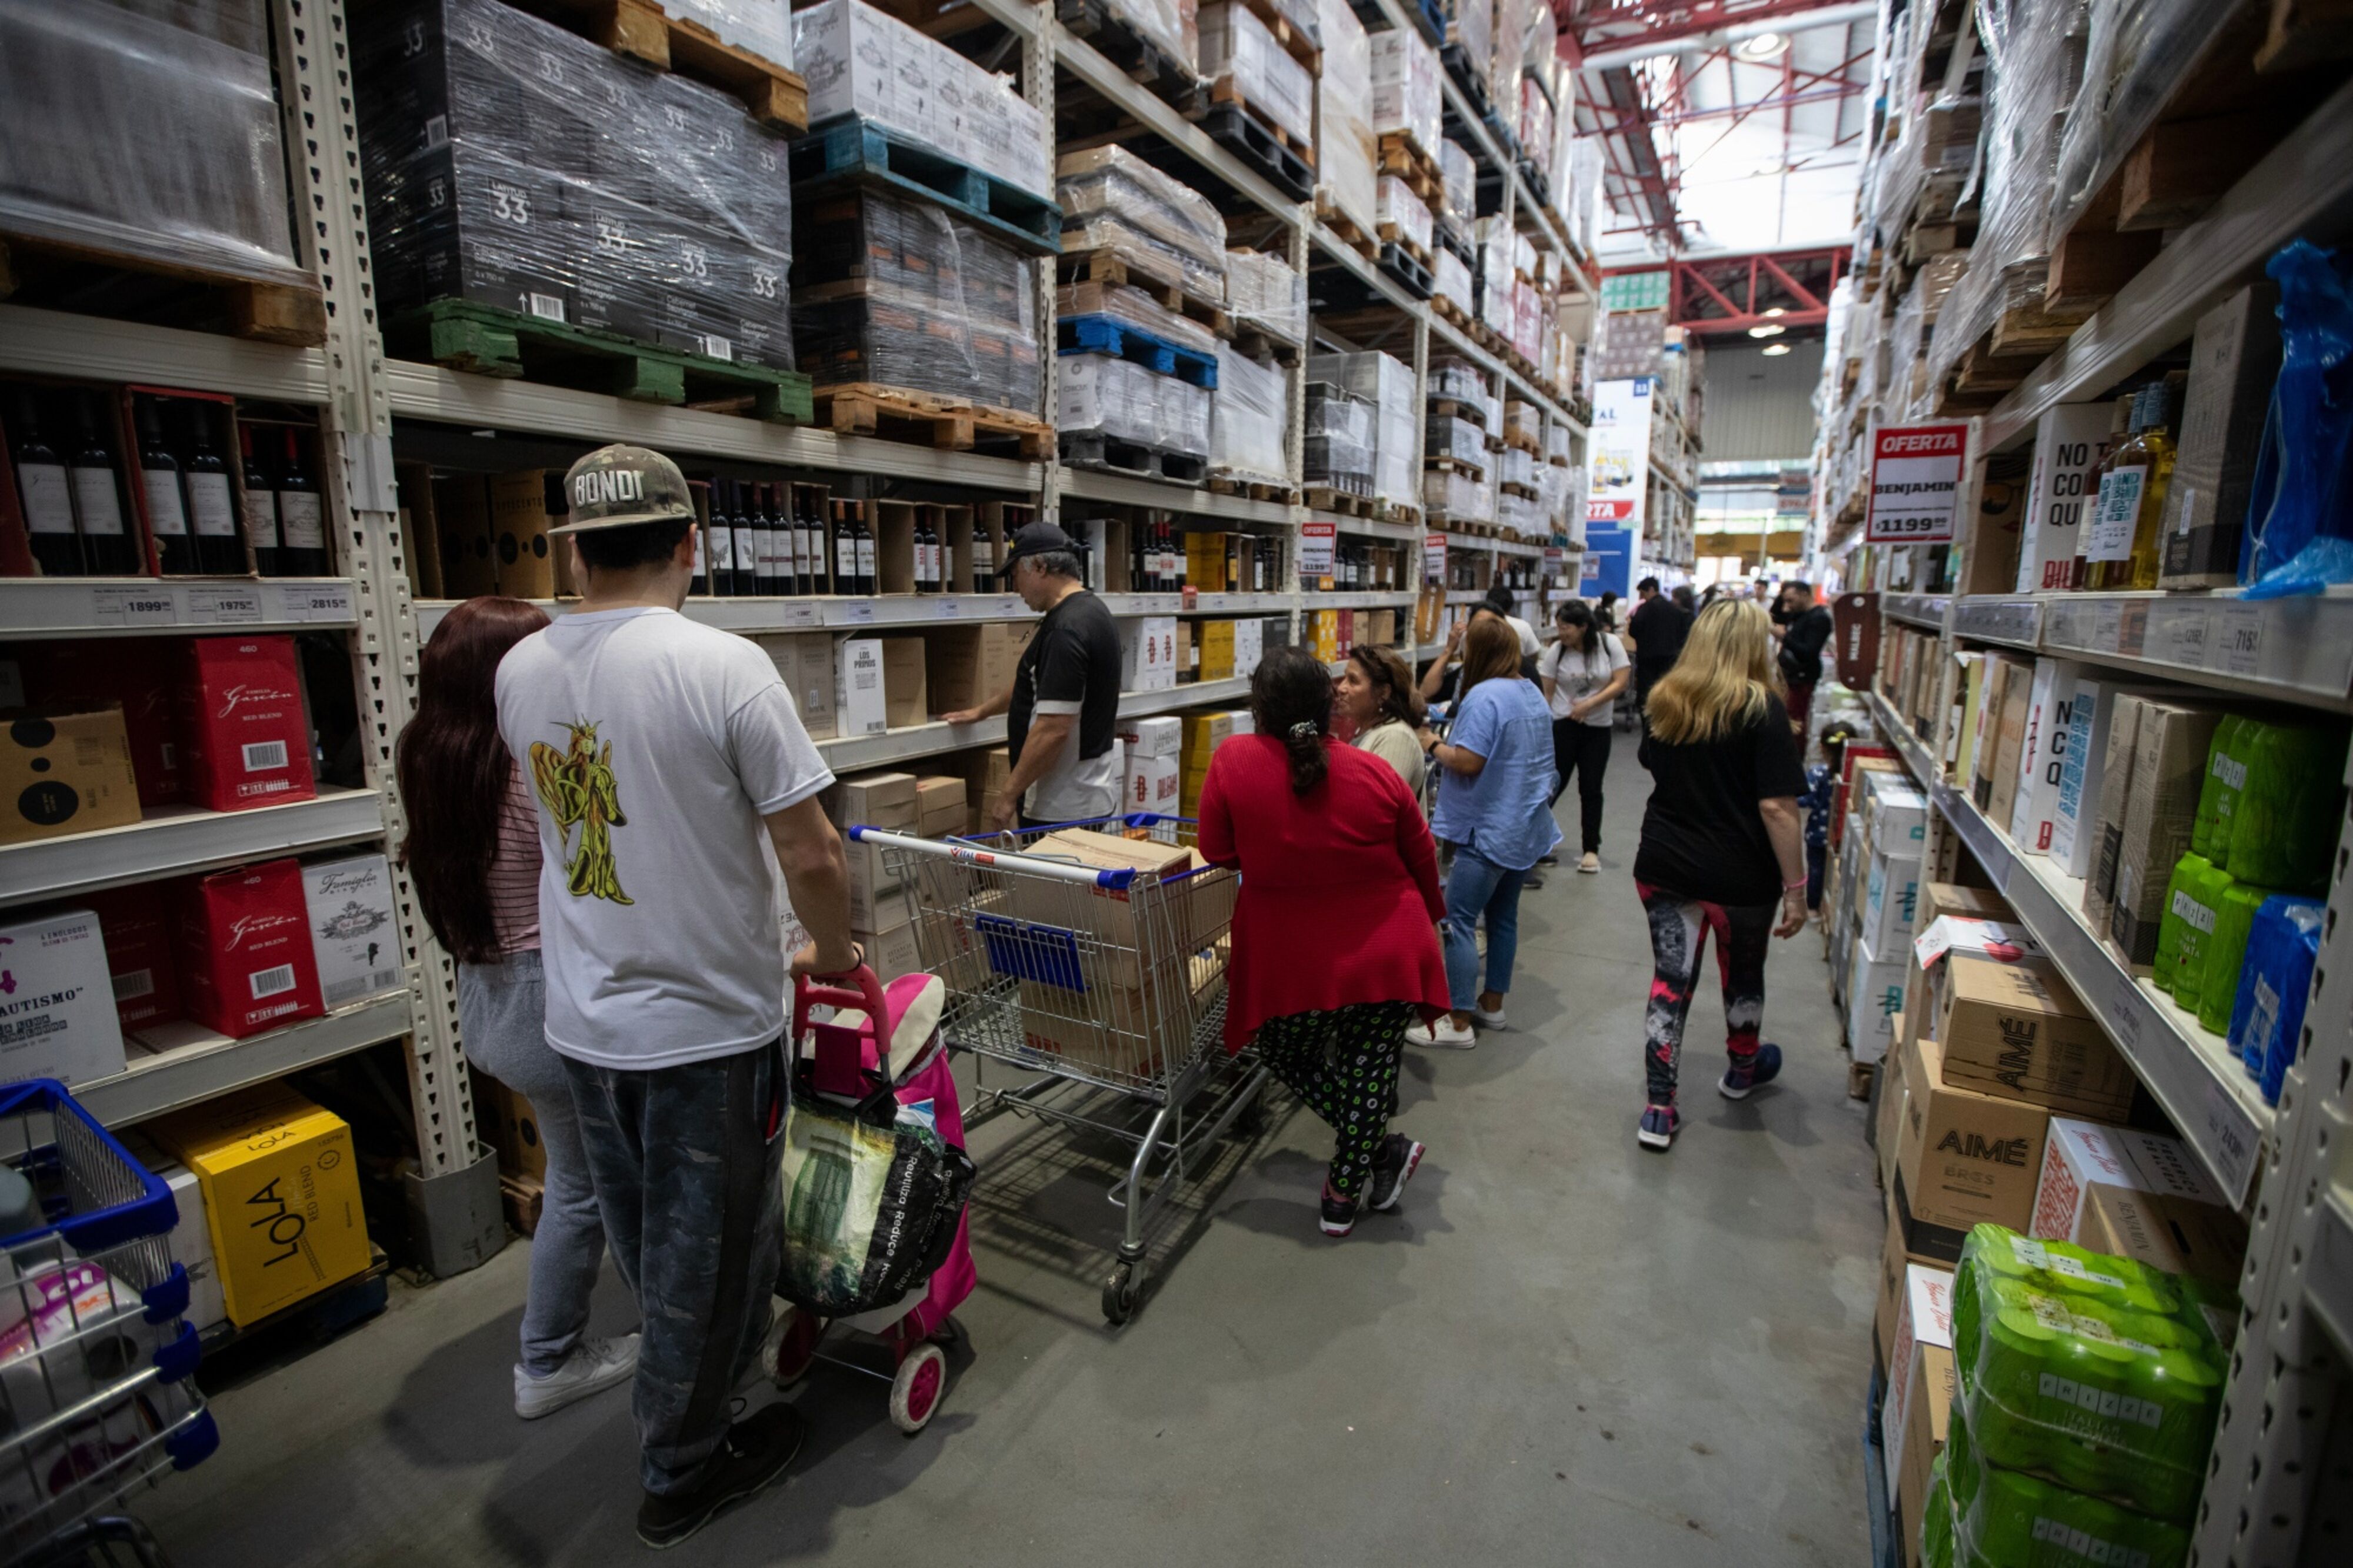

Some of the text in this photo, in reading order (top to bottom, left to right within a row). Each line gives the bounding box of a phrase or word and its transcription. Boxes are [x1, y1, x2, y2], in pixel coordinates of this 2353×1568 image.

[1881, 432, 1959, 453] OFERTA
[2057, 442, 2088, 467] NO
[574, 469, 644, 508] BONDI
[1874, 481, 1956, 496] BENJAMIN
[2052, 472, 2084, 497] CO
[2049, 503, 2079, 527] QU
[1304, 526, 1332, 535] OFERTA
[126, 600, 162, 612] 1899
[311, 599, 339, 609] 2815
[238, 645, 258, 653] 460
[859, 651, 870, 660] LOS
[854, 659, 876, 669] PRIMOS
[242, 711, 283, 722] RED BLEND
[243, 875, 262, 885] 460
[318, 868, 378, 895] Famiglia
[1995, 1012, 2040, 1093] AIMÉ
[246, 1130, 298, 1152] LOLA
[1937, 1129, 2029, 1167] AIMÉ
[299, 1164, 319, 1223] RED BLEND
[244, 1176, 306, 1268] LOLA
[886, 1210, 905, 1257] Reduce
